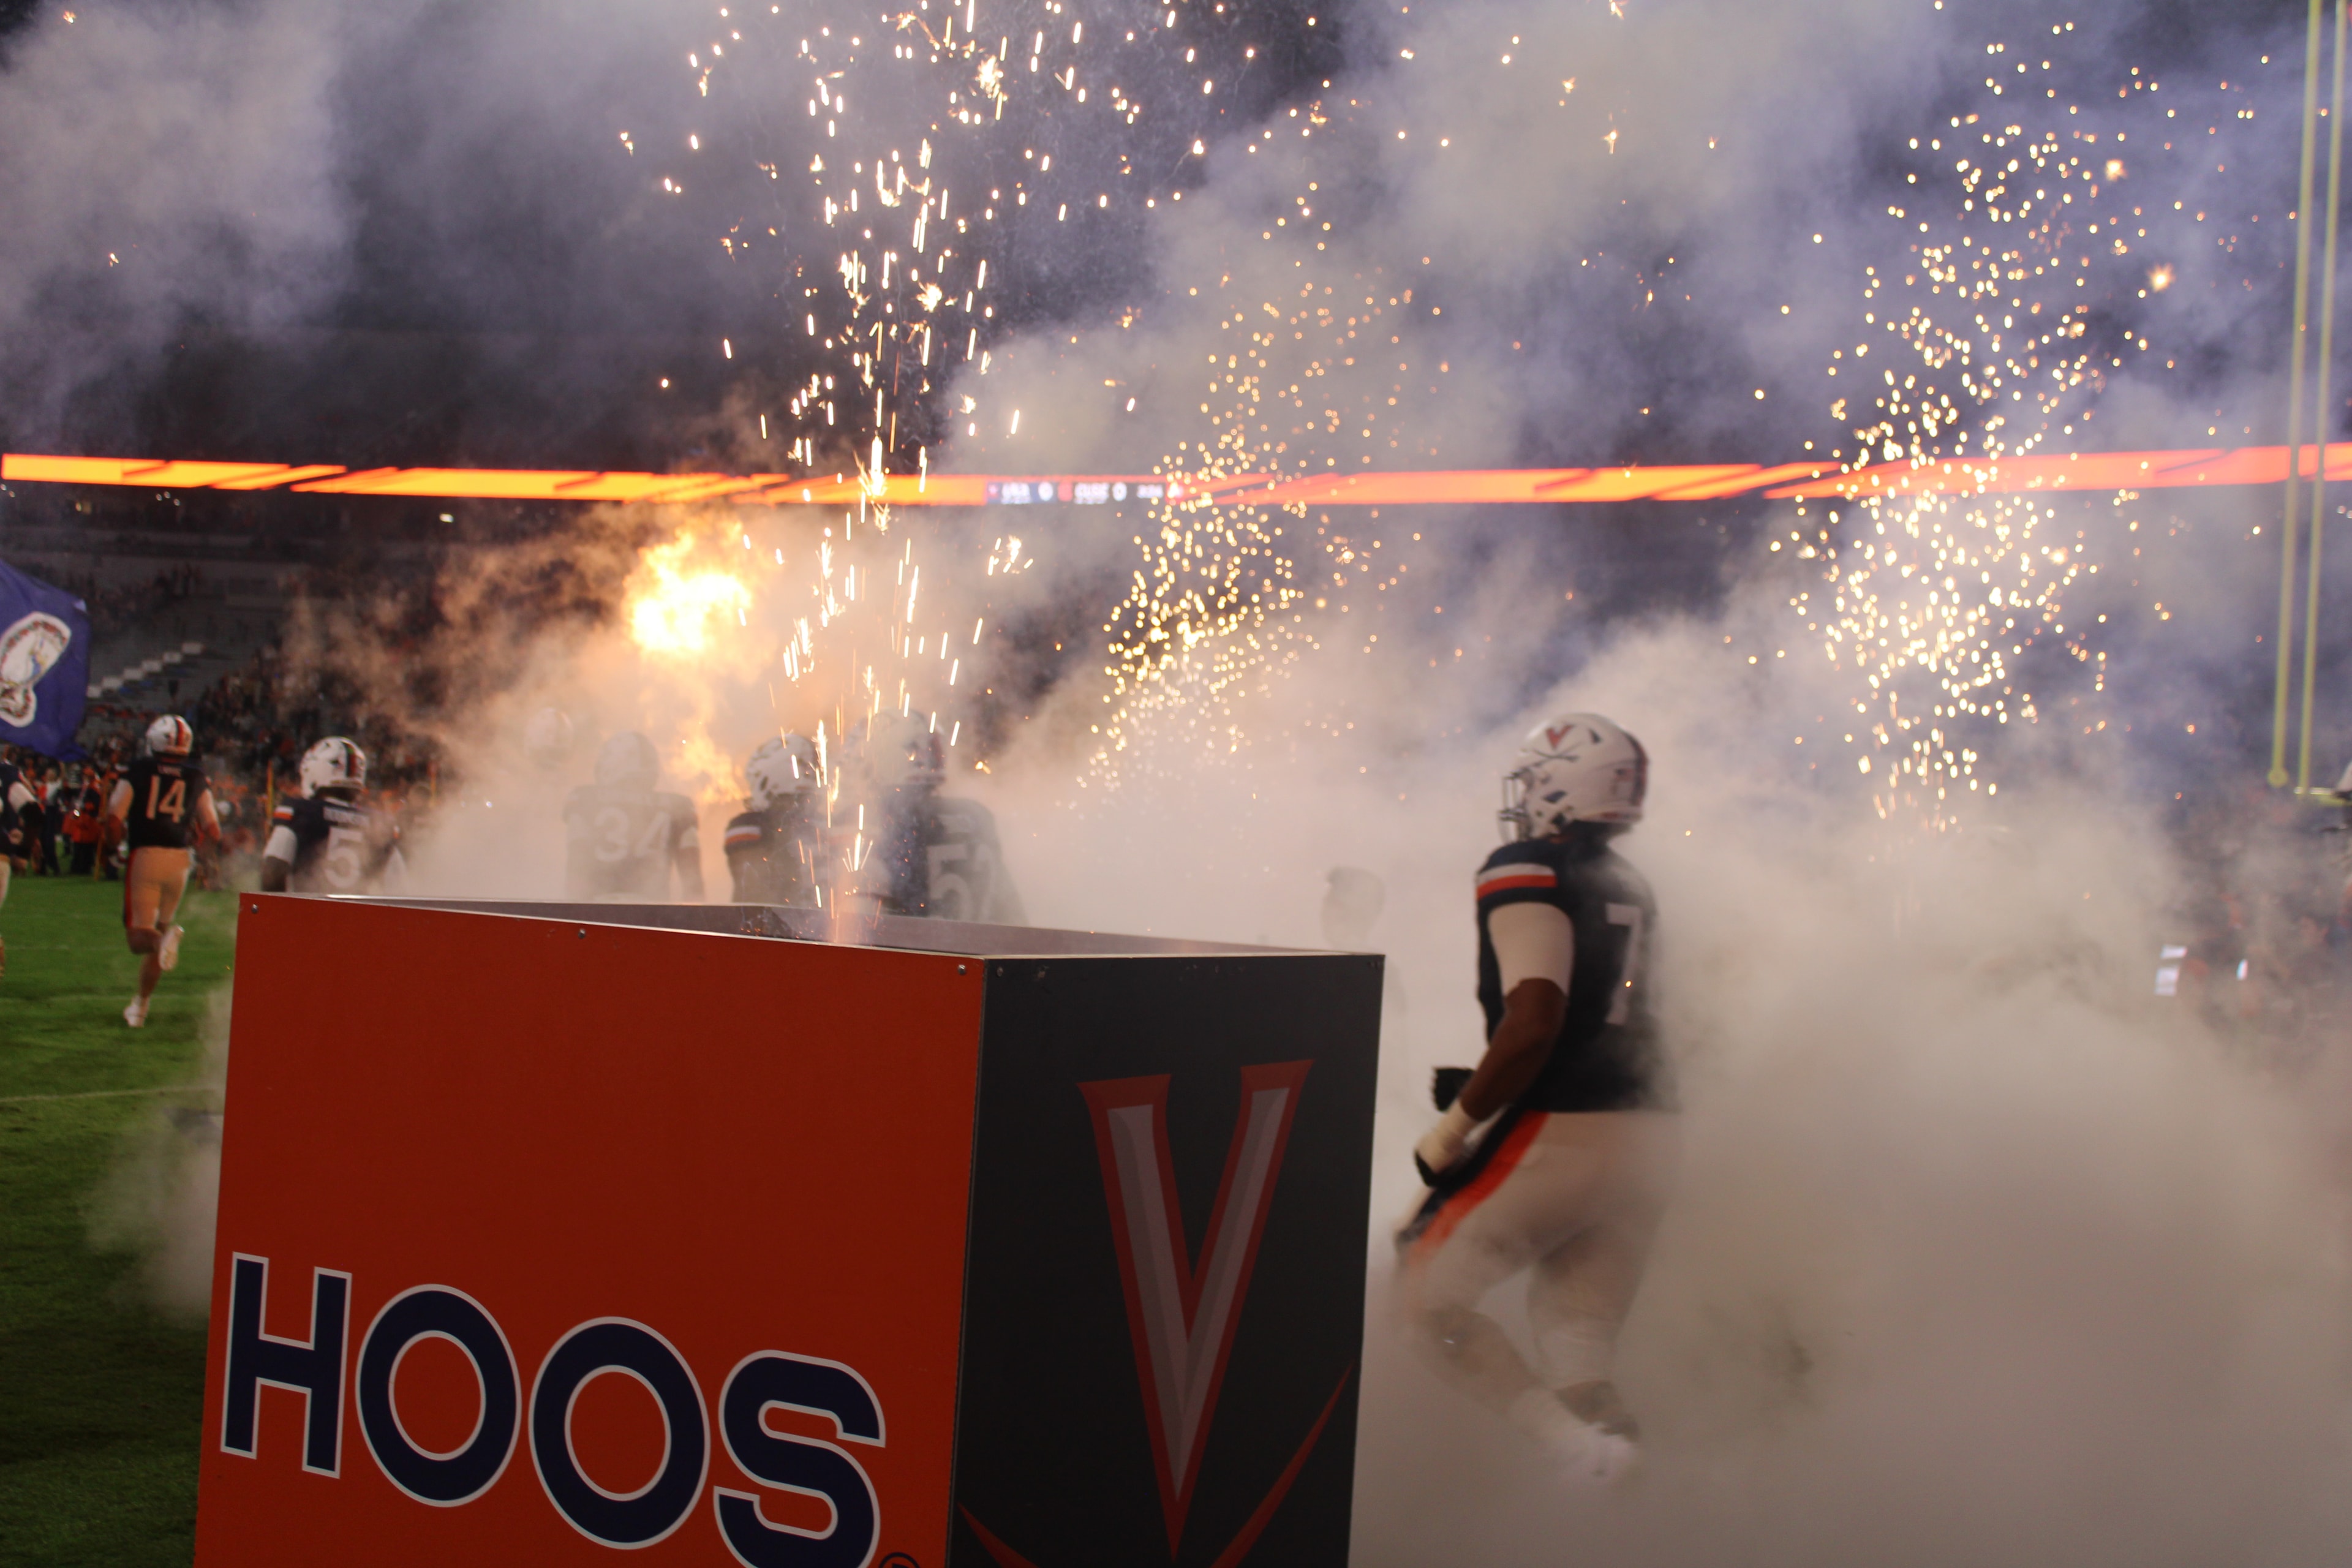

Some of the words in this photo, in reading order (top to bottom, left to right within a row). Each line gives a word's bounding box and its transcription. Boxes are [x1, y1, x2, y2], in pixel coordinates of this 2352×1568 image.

[146, 774, 186, 823] 14
[323, 826, 364, 888] 5
[594, 806, 669, 870] 34
[1076, 1059, 1315, 1562] V
[221, 1251, 886, 1568] HOOS
